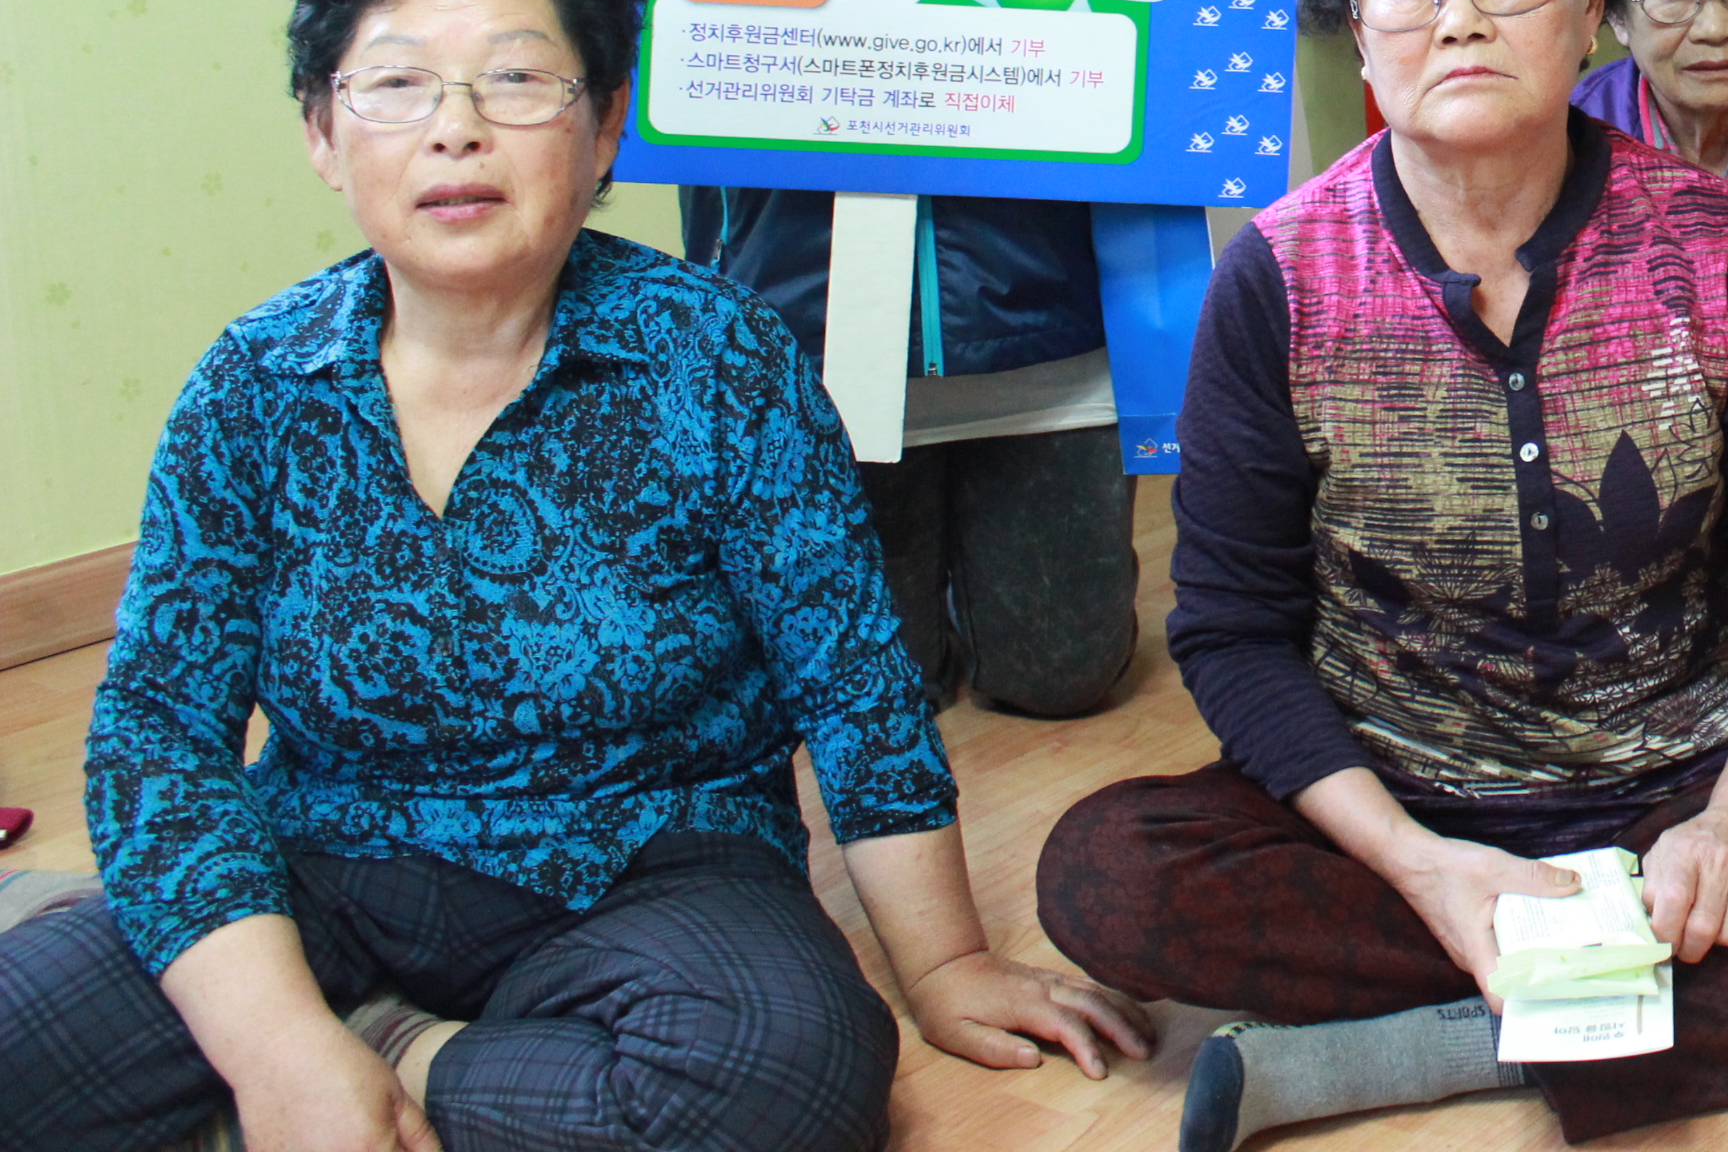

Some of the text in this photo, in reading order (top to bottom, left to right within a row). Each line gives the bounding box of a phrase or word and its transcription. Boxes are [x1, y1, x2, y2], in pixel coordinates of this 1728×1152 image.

[1011, 38, 1046, 58] 기부
[1069, 70, 1105, 89] 기부
[686, 80, 1016, 113] 선거관리위원회 기탁금 계좌로 직접이체
[846, 119, 972, 138] 포천시선거관리위원회
